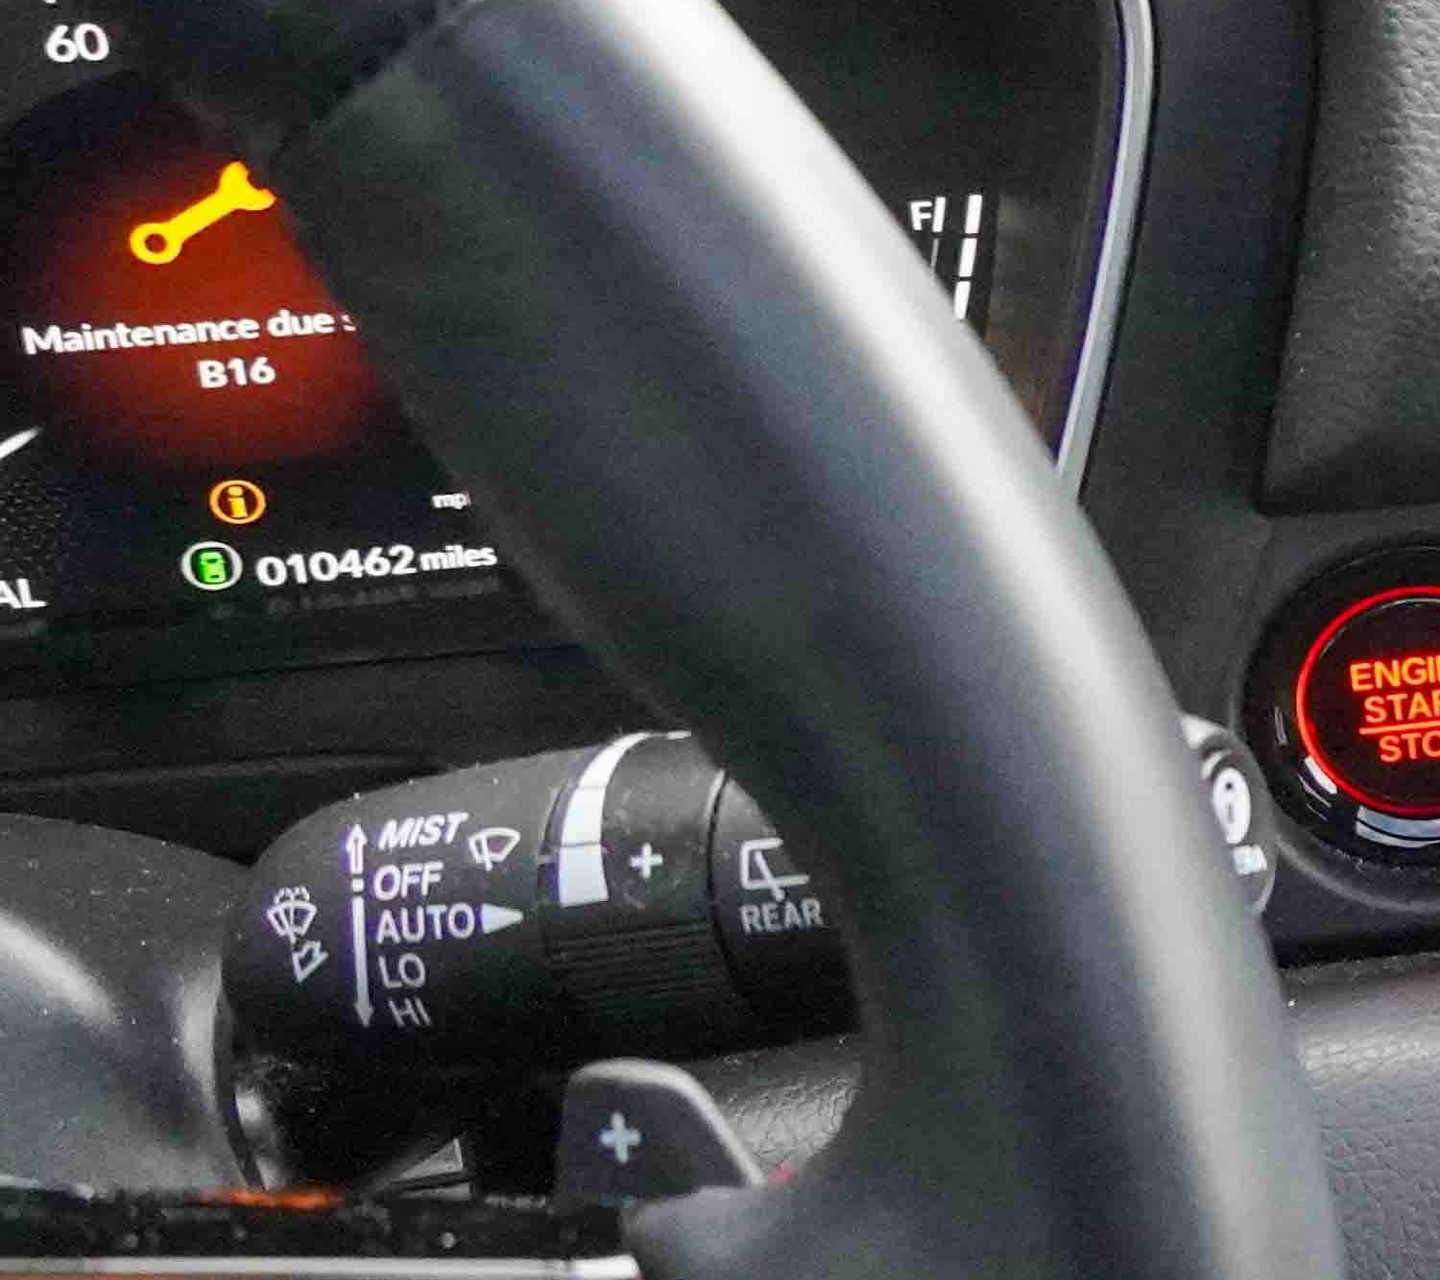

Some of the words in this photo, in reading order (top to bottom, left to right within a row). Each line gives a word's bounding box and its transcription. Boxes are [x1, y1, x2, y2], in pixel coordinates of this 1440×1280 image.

[45, 23, 110, 63] 60
[910, 201, 932, 231] F
[21, 318, 260, 355] Maintenance
[266, 310, 335, 338] due
[197, 357, 276, 390] B16
[431, 489, 471, 510] mp
[254, 544, 417, 587] 010462
[419, 543, 498, 572] miles
[379, 812, 469, 850] MIST
[373, 862, 442, 901] OFF
[376, 902, 475, 945] AUTO
[739, 901, 823, 934] REAR
[379, 953, 426, 988] LO
[390, 1000, 432, 1027] HI
